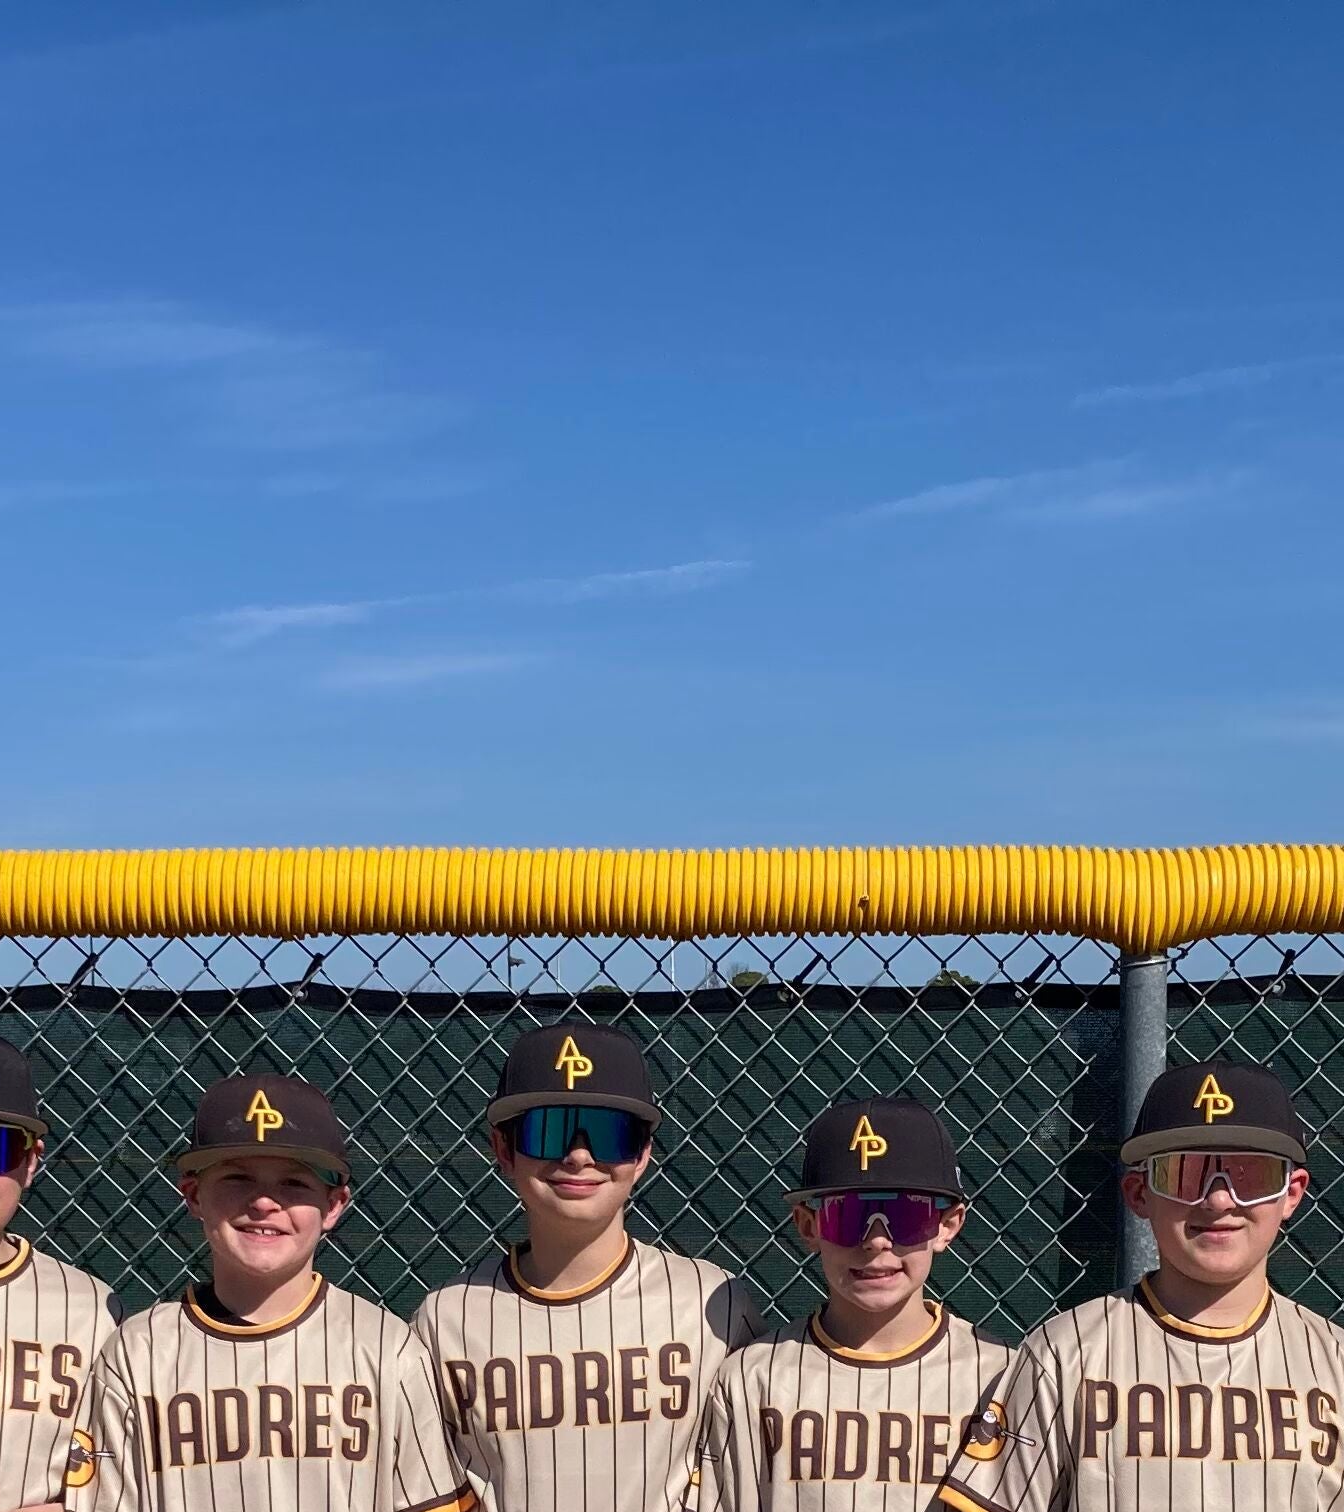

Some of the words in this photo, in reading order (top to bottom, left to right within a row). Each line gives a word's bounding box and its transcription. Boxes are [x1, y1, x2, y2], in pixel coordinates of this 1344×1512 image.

[554, 1035, 594, 1091] AP
[245, 1089, 285, 1143] AP
[1192, 1073, 1235, 1124] AP
[849, 1115, 888, 1171] AP
[443, 1341, 693, 1436] PADRES
[759, 1406, 981, 1485] PADRE
[1081, 1377, 1341, 1468] PADRES
